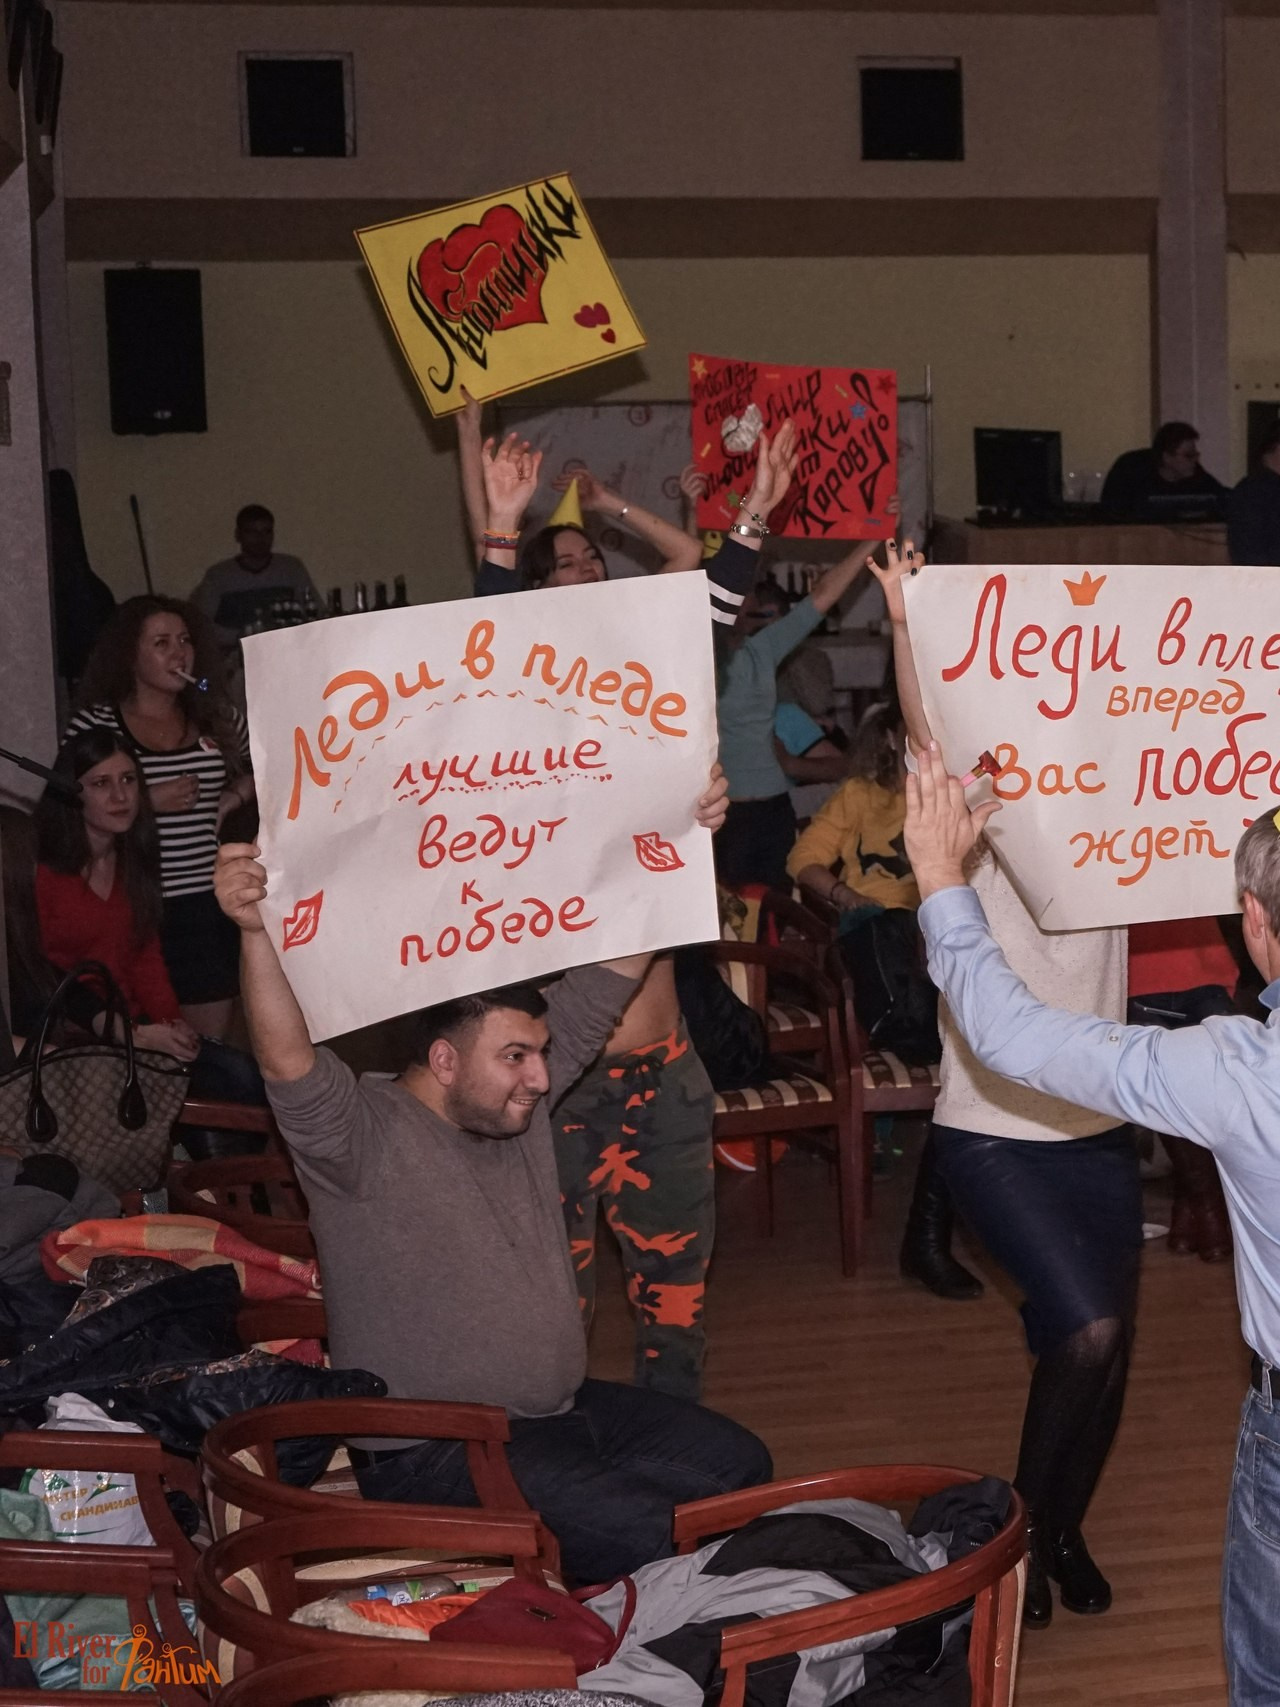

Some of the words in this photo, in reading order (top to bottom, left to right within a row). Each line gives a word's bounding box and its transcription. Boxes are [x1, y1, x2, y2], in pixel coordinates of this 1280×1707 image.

[941, 573, 1127, 721] Леди
[1157, 596, 1193, 666] в
[286, 660, 445, 821] Леди
[460, 619, 496, 680] в
[521, 642, 688, 738] пледе
[1105, 678, 1246, 732] вперед
[393, 738, 608, 806] лучшие
[992, 742, 1107, 801] Вас
[418, 813, 569, 870] ведут
[1069, 819, 1231, 887] ждет
[461, 879, 485, 905] к
[400, 895, 600, 967] победе
